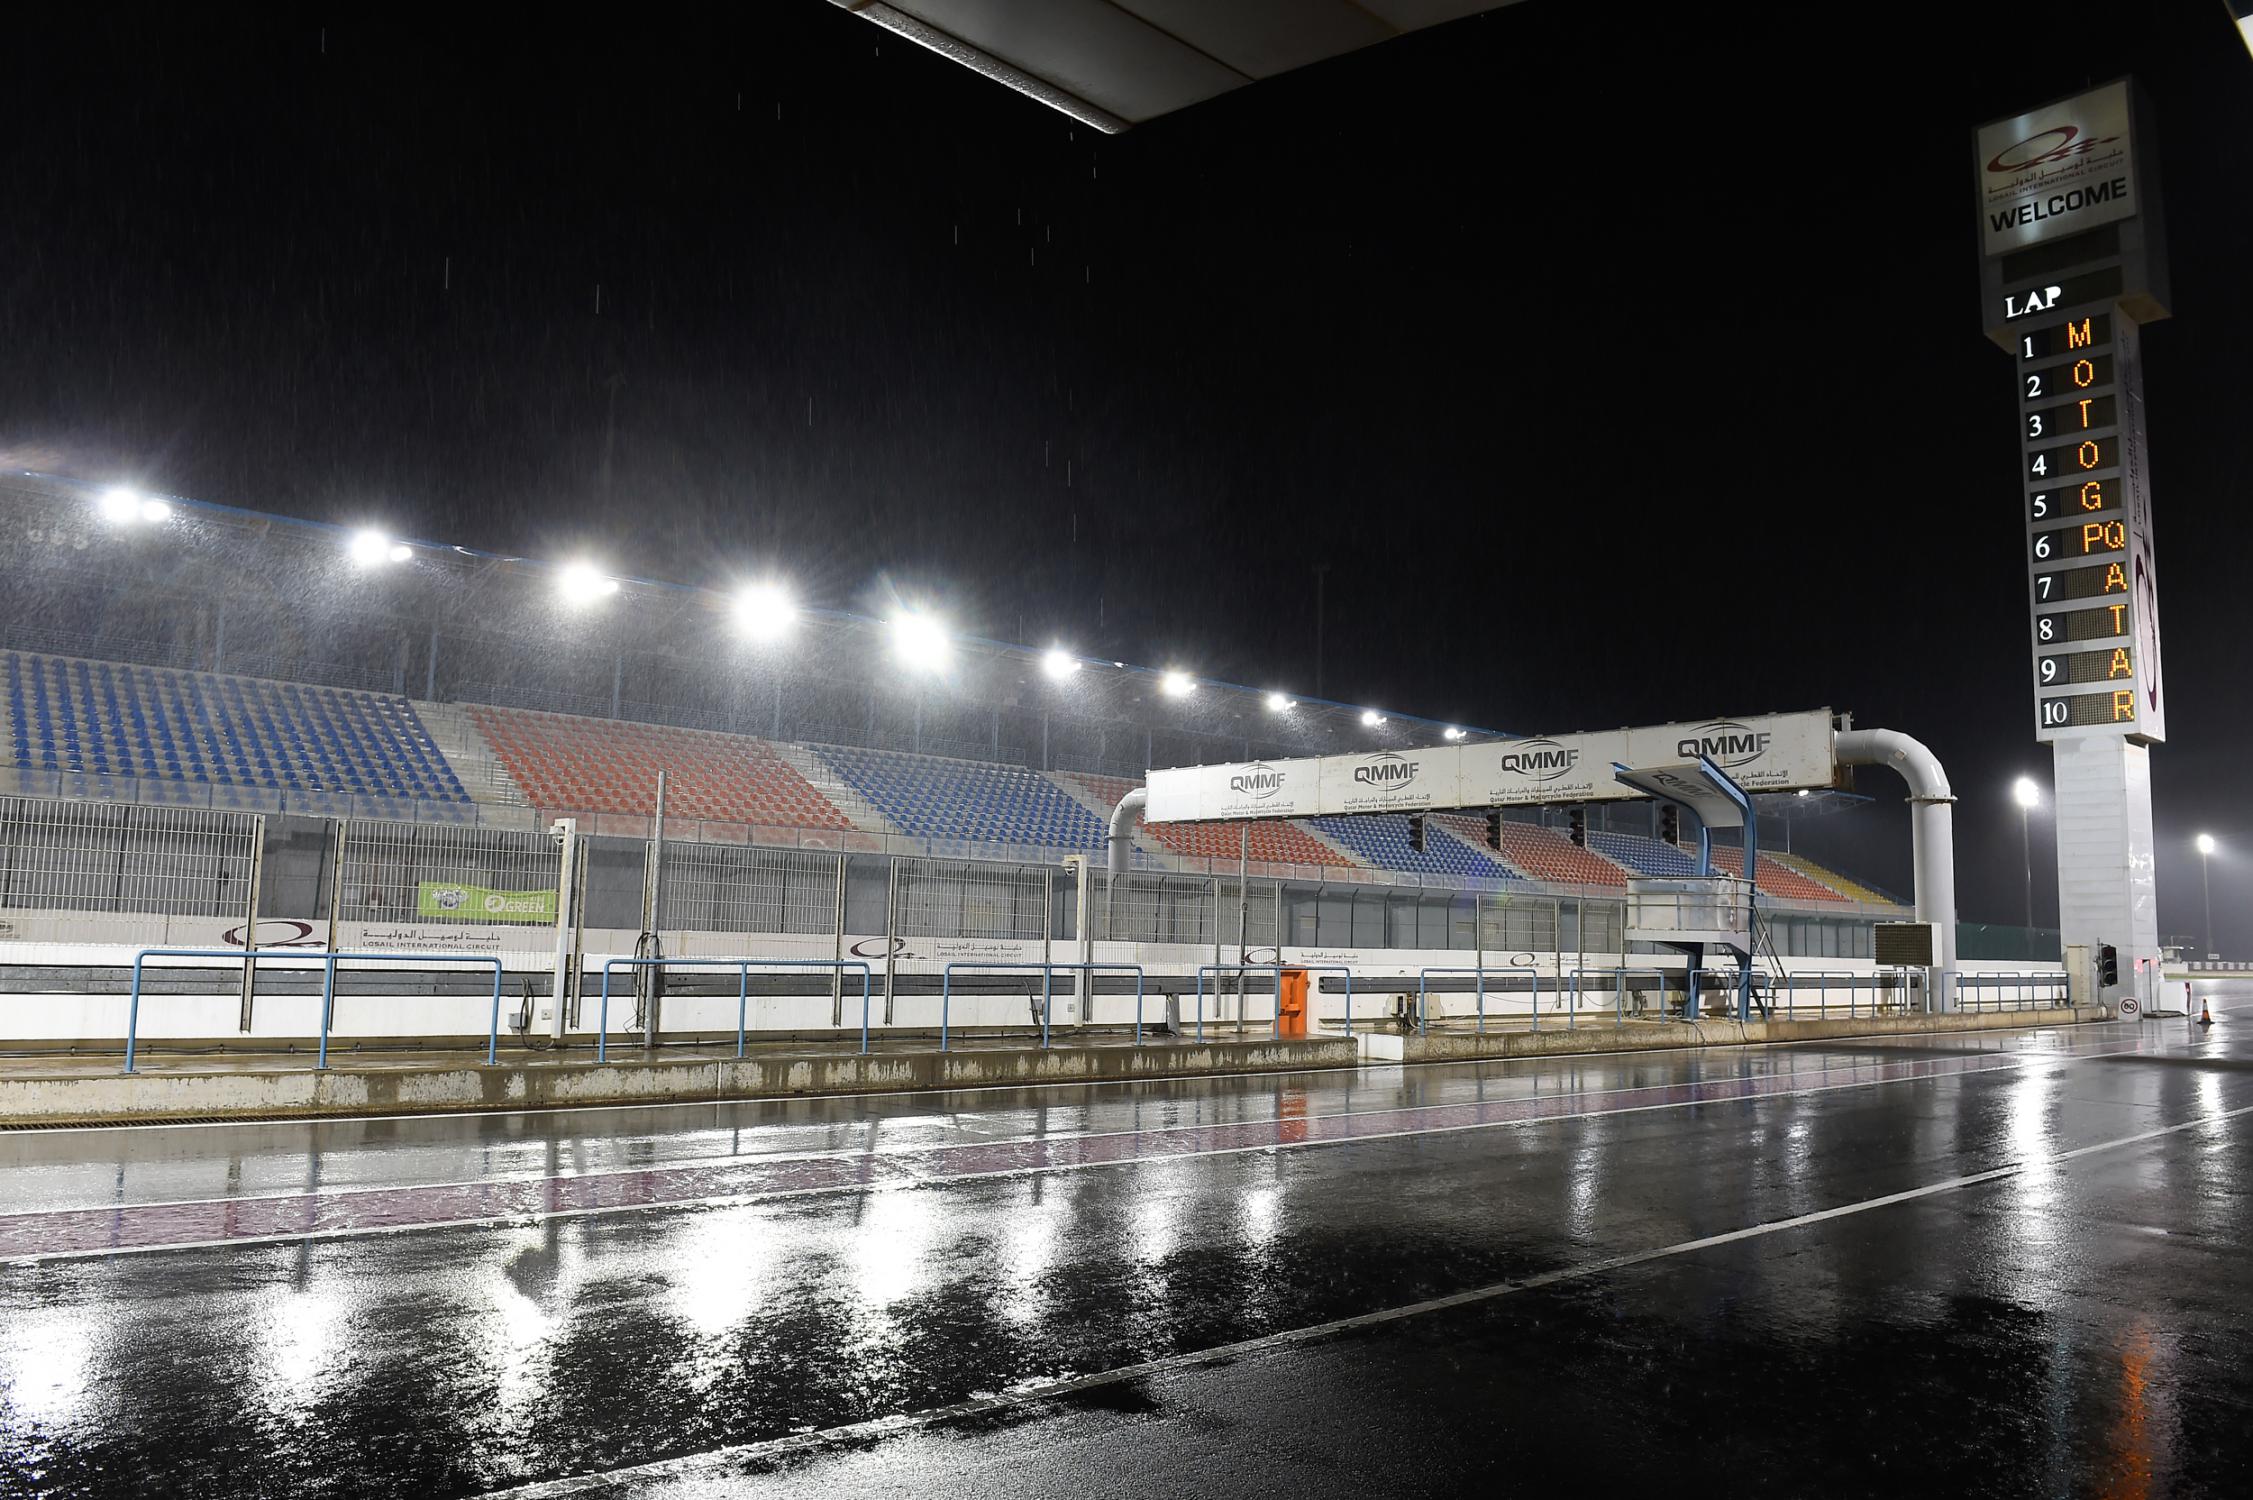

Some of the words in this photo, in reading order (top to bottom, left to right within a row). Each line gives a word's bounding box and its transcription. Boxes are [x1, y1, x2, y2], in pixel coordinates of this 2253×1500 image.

[2019, 169, 2086, 194] INTERNATIONAL
[1990, 176, 2127, 232] WELCOME
[2005, 286, 2062, 318] LAP
[2024, 336, 2034, 358] 1
[2027, 375, 2041, 398] 2
[2029, 415, 2042, 437] 3
[2032, 454, 2047, 476] 4
[2034, 495, 2047, 518] 5
[2035, 535, 2050, 558] 6
[2038, 576, 2051, 599] 7
[2039, 618, 2053, 641] 8
[2041, 659, 2056, 683] 9
[2043, 702, 2067, 725] 10
[1677, 732, 1771, 757] QMMF
[1501, 749, 1579, 772] QMMF
[1230, 773, 1286, 791] QMMF
[1354, 762, 1419, 783] QMMF
[506, 901, 545, 913] GREEN
[397, 942, 462, 950] INTERNATIONAL
